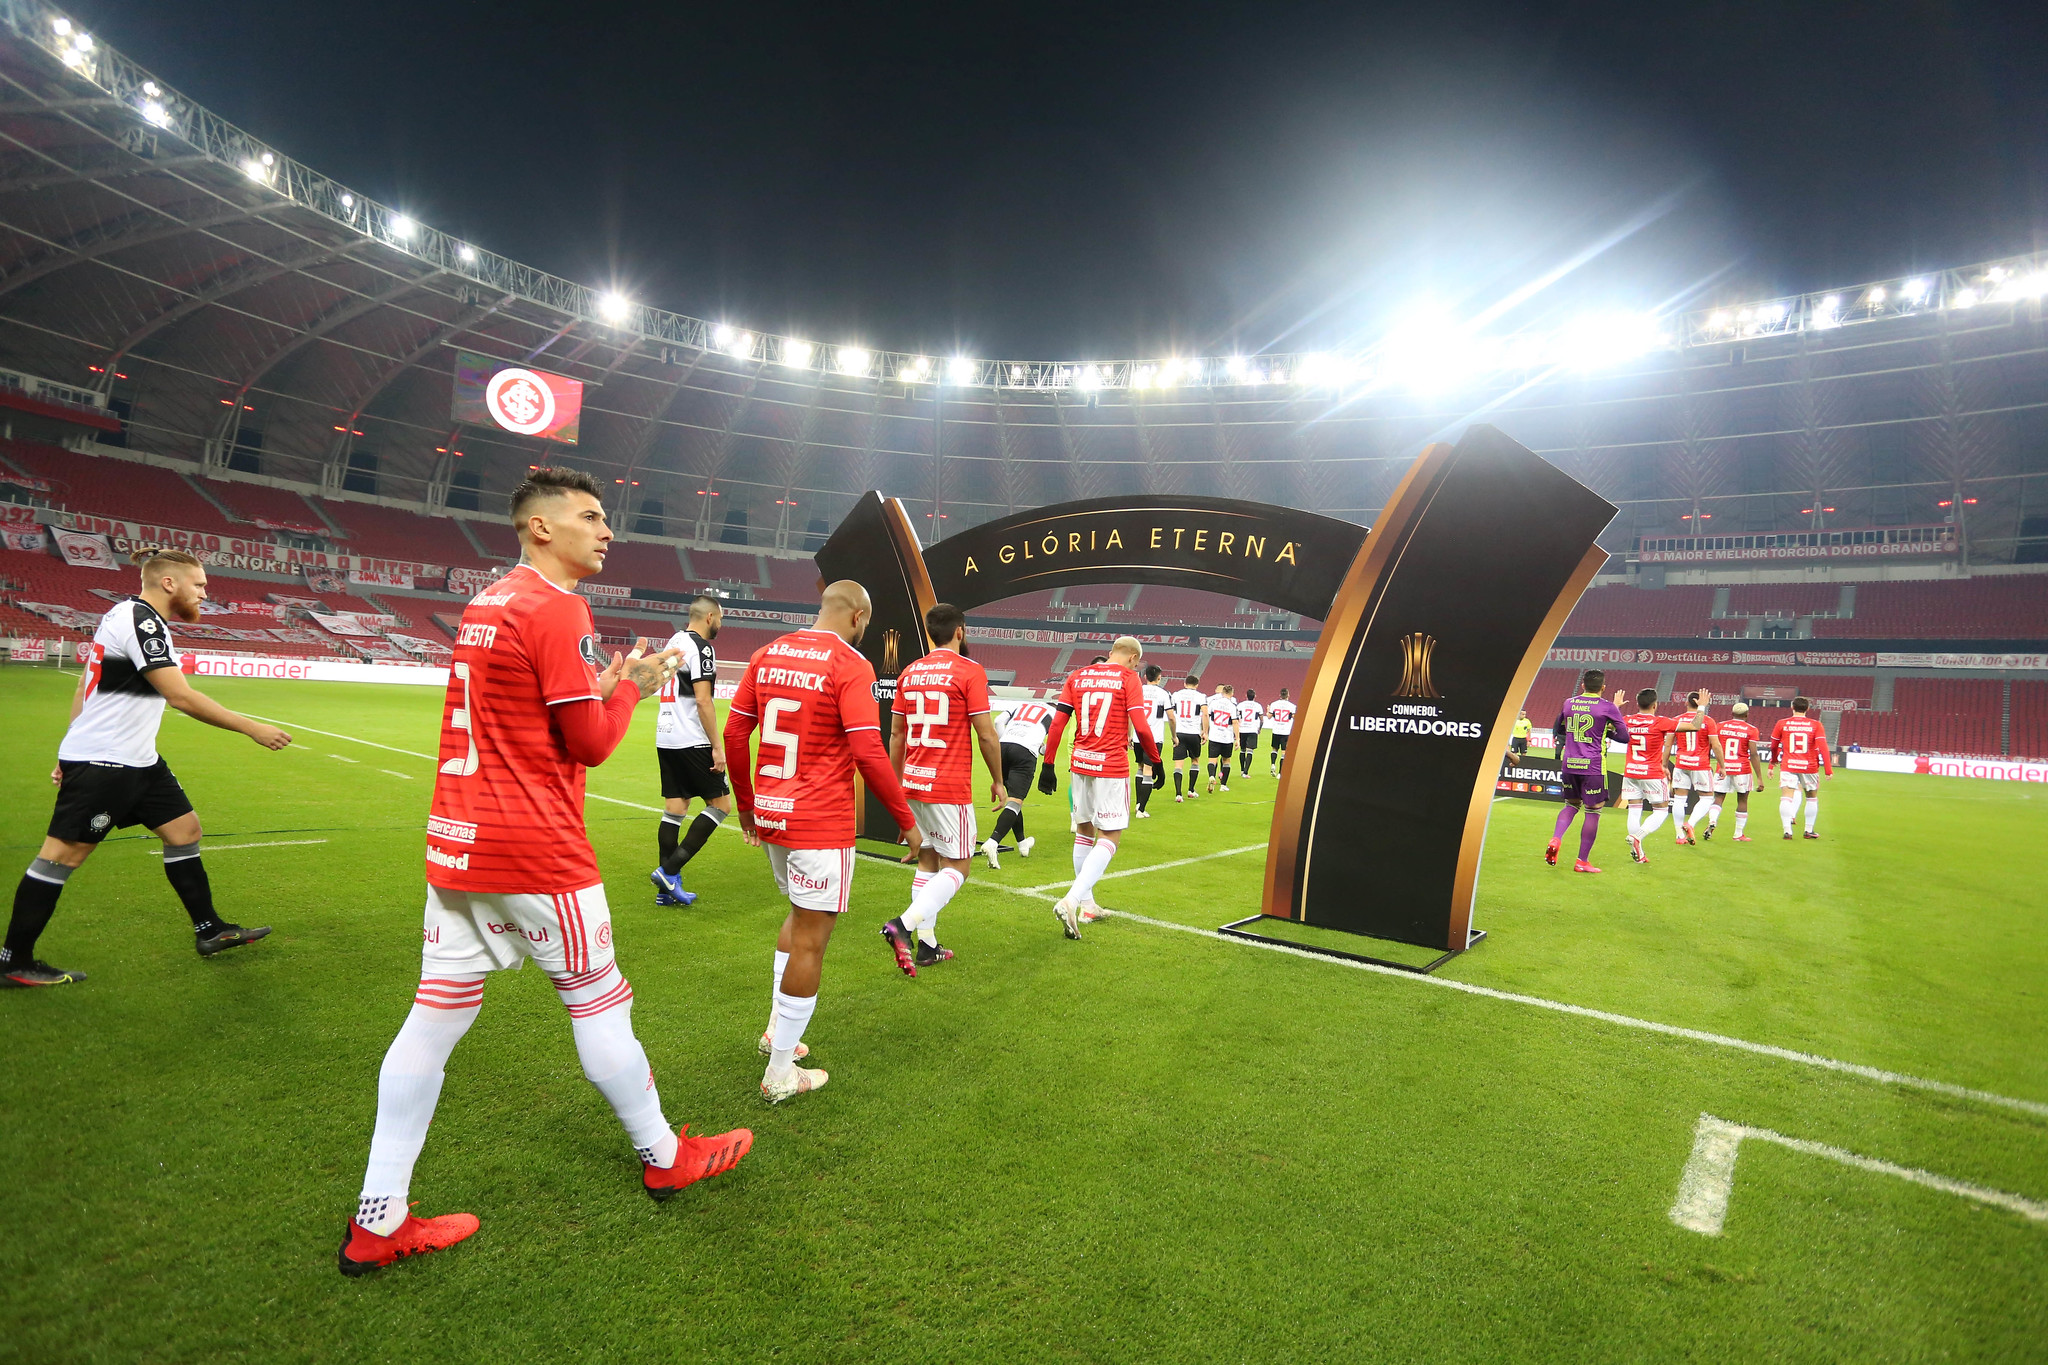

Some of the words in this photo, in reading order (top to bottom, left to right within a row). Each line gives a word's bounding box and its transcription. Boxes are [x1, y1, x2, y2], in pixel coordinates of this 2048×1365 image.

[75, 514, 129, 539] UMA
[231, 539, 276, 560] QUE
[287, 549, 328, 567] AMA
[337, 556, 350, 569] O
[360, 558, 424, 576] INTER
[965, 556, 979, 577] A
[999, 530, 1123, 564] GLÓRIA
[1150, 528, 1297, 567] ETERNA
[1652, 552, 1661, 561] A
[1664, 551, 1703, 561] MAIOR
[1706, 551, 1713, 560] E
[1715, 549, 1768, 560] MELHOR
[1771, 547, 1828, 558] TORCIDA
[1832, 546, 1850, 556] DO
[1853, 545, 1877, 555] RIO
[1880, 543, 1942, 554] GRANDE
[358, 571, 381, 584] ZONA
[595, 586, 625, 596] CAXIAS
[723, 608, 781, 620] IAMÃO
[778, 643, 832, 662] Banrisul
[1215, 639, 1242, 650] ZONA
[1246, 640, 1281, 652] NORTE
[1547, 649, 1620, 663] TRIUNFO
[1804, 657, 1862, 665] GRAMADO
[180, 654, 312, 679] antander
[915, 661, 953, 671] Banrisul
[1088, 669, 1122, 677] Banrisul
[1013, 703, 1048, 725] 10
[1081, 691, 1113, 738] 17
[1179, 700, 1192, 719] 11
[1243, 708, 1253, 723] 2
[1273, 708, 1290, 723] 32
[1571, 704, 1591, 712] DANIEL
[439, 661, 480, 776] 3
[903, 690, 950, 749] 22
[1213, 709, 1231, 728] 22
[1350, 715, 1482, 738] LIBERTADORES
[1566, 713, 1594, 743] 42
[758, 697, 802, 780] 5
[1630, 734, 1647, 762] 2
[1685, 731, 1697, 752] 11
[1788, 732, 1808, 754] 13
[1724, 737, 1740, 760] 8
[1073, 760, 1103, 772] Unimed
[1504, 767, 1563, 783] LIBERTAD
[754, 796, 795, 811] mericanas
[427, 819, 477, 841] americanas
[426, 844, 470, 871] Unimed
[788, 865, 829, 891] betsul
